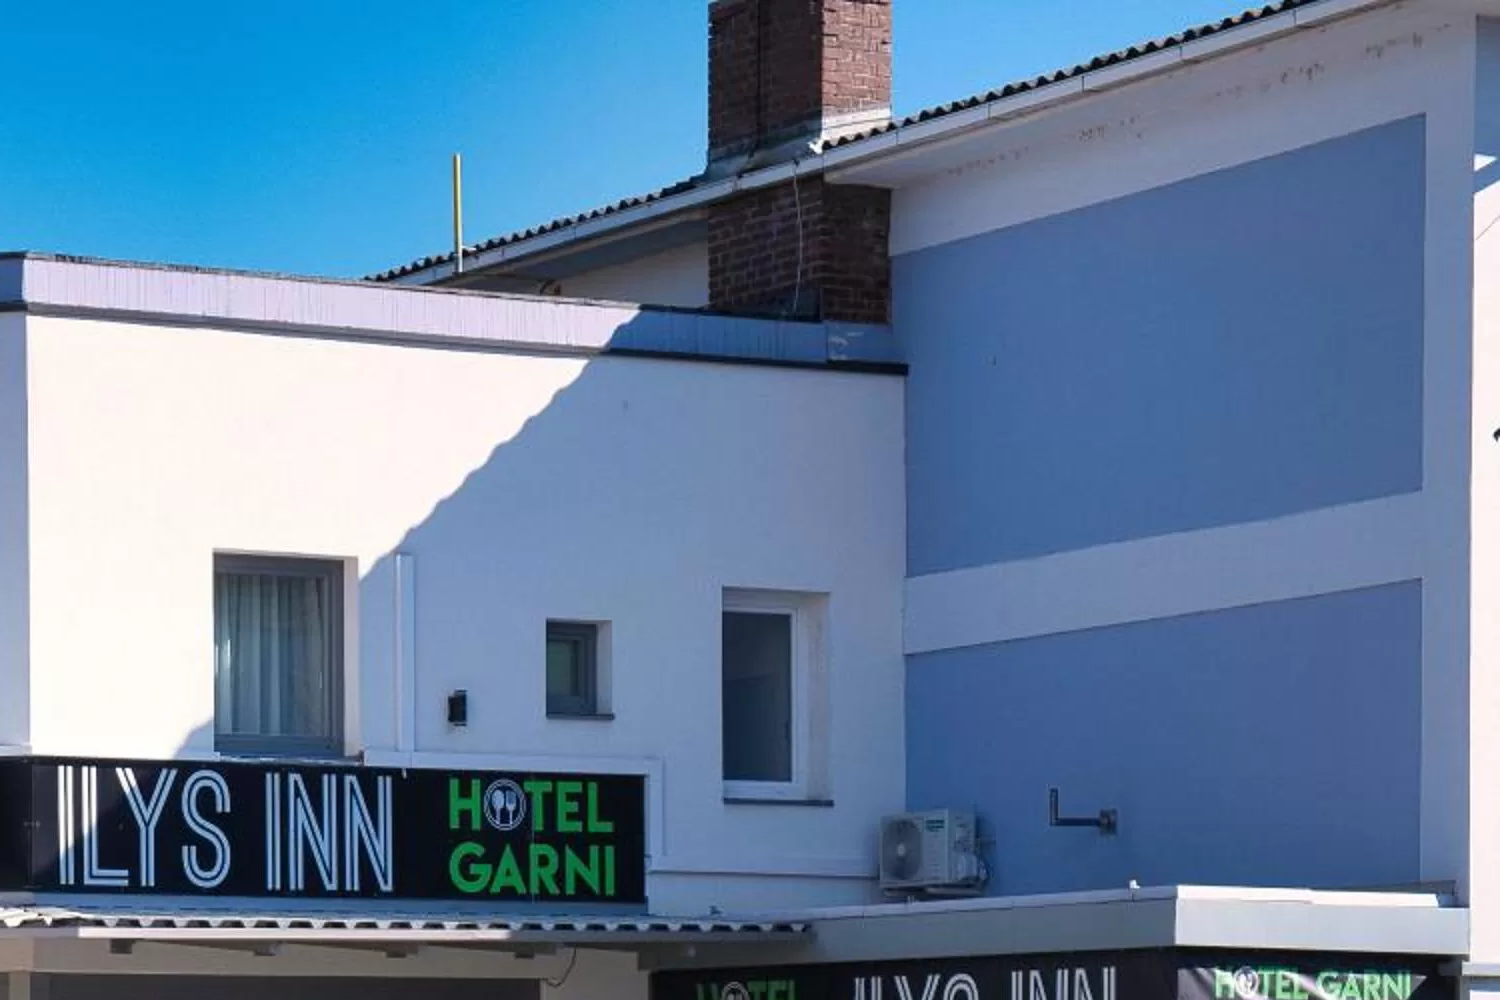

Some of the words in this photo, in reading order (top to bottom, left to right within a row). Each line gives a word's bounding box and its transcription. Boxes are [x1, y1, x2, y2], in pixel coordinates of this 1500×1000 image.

[57, 765, 231, 888] ILYS
[265, 772, 394, 892] INN
[448, 778, 615, 834] HOTEL
[448, 842, 616, 896] GARNI
[1214, 966, 1309, 1000] HOTEL
[1316, 970, 1411, 1000] GARNI
